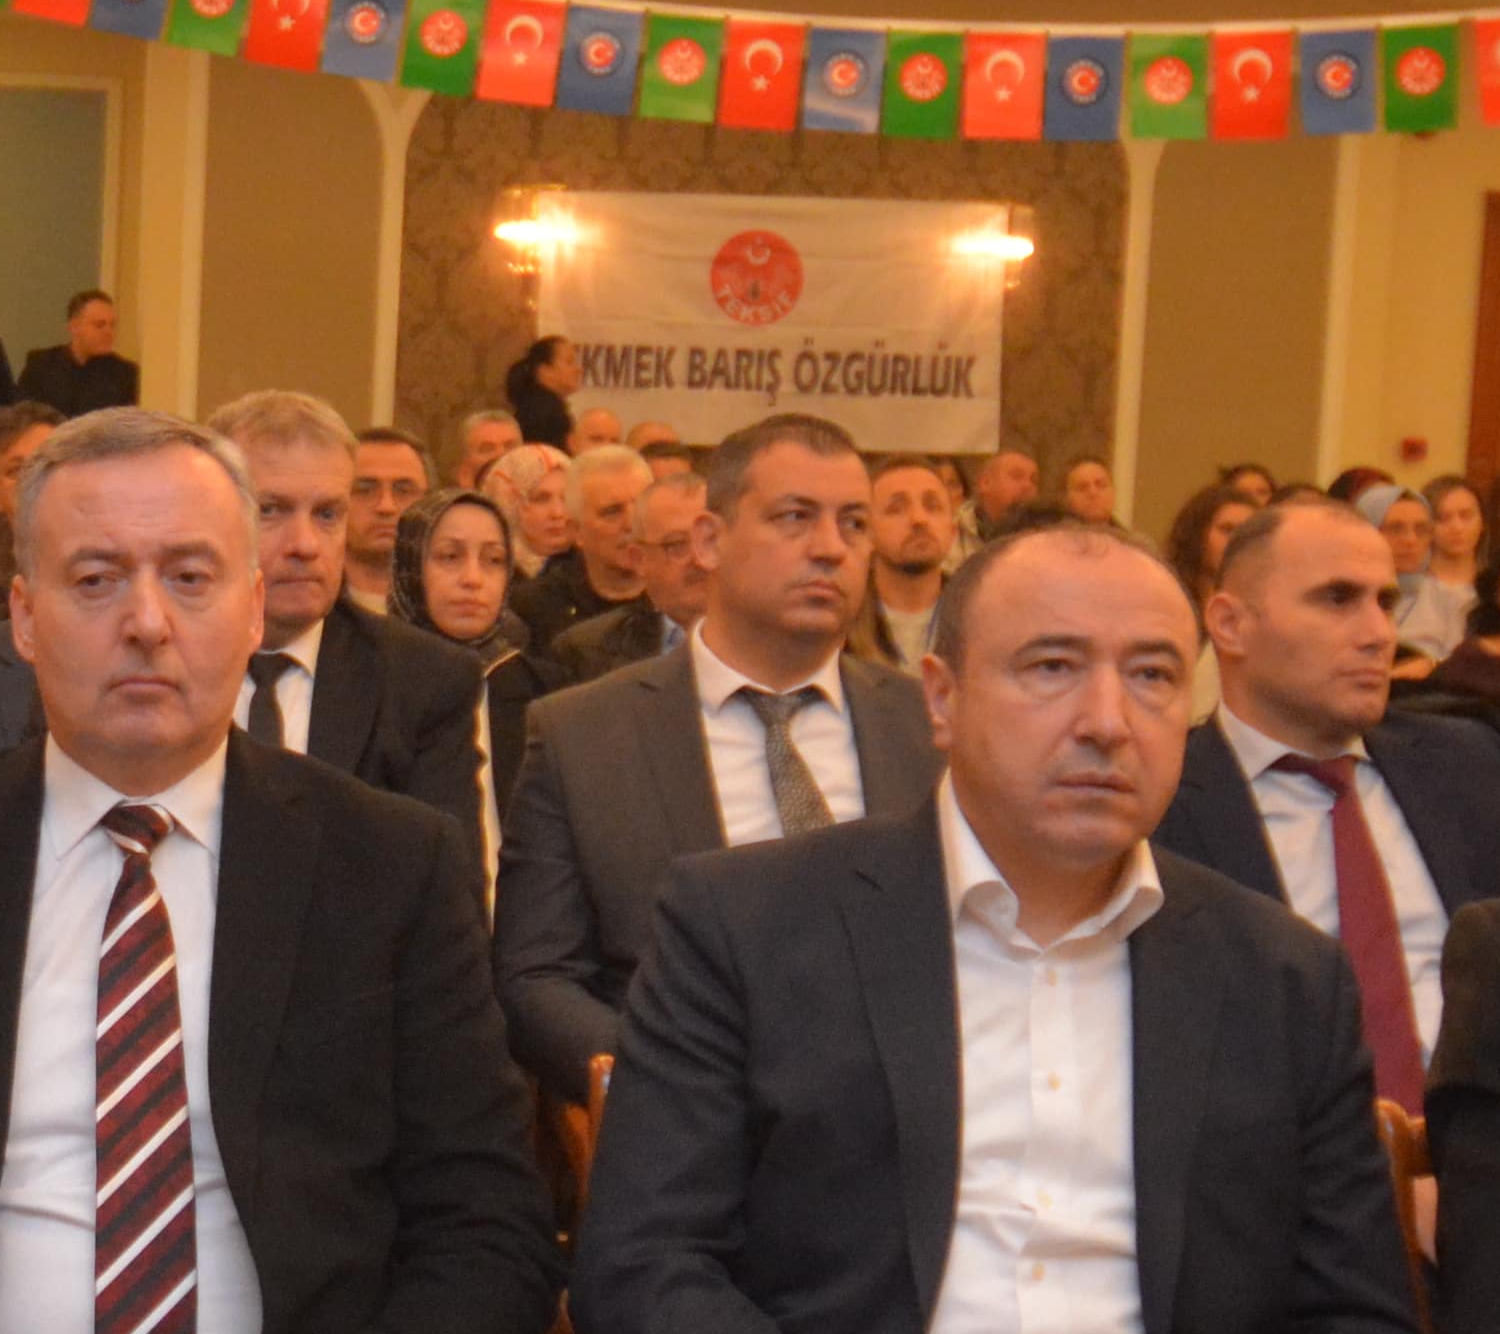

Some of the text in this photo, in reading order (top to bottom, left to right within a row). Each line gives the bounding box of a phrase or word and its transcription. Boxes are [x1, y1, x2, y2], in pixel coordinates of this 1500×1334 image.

[717, 283, 795, 323] TEKSİF
[573, 338, 977, 407] KMEK BARIŞ ÖZGÜRLÜK
